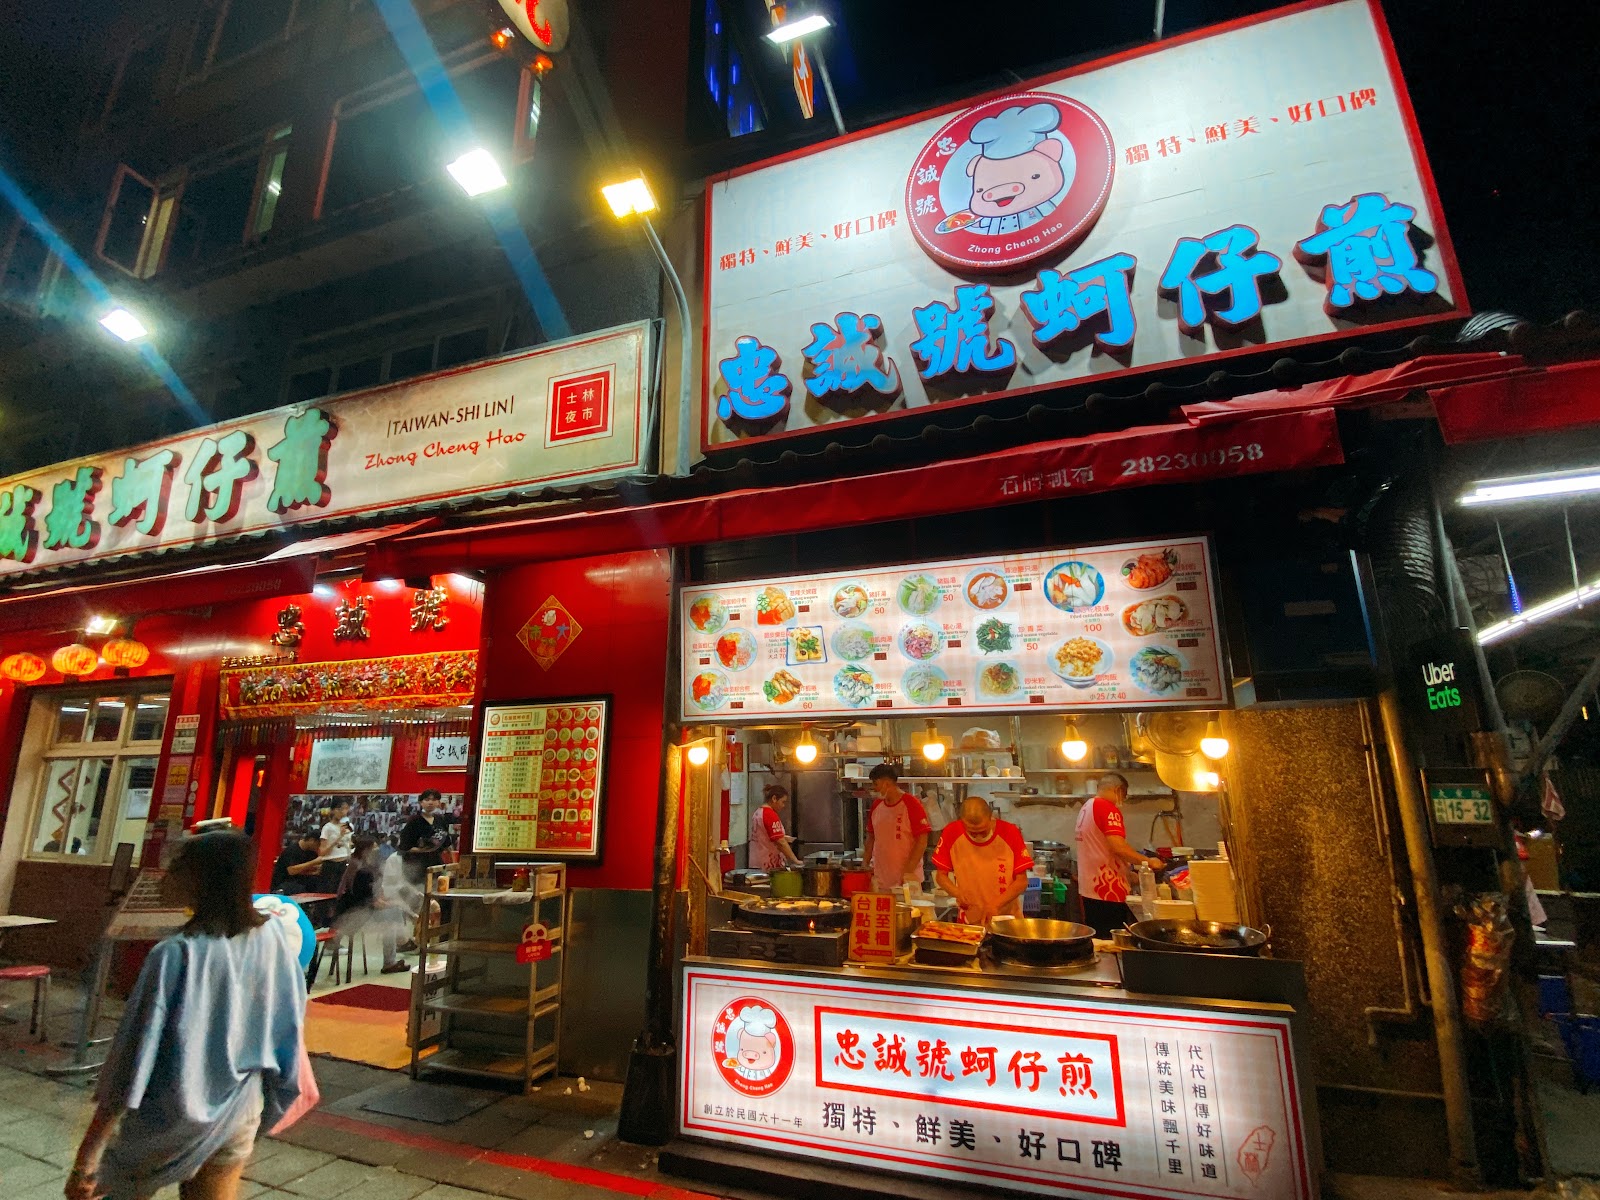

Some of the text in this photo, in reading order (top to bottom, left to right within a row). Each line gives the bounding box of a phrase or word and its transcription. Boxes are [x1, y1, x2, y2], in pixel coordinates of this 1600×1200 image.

[1125, 88, 1377, 165] 獨特、鮮美、好口碑
[719, 209, 897, 271] 獨特、鮮美、好口碑
[968, 222, 1063, 254] Zhong Cheng Hao
[717, 192, 1440, 421] 忠誠號蚵仔煎
[566, 388, 595, 404] 士林
[565, 407, 593, 424] 夜市
[364, 428, 527, 470] Zhong Cheng Hao
[1084, 624, 1102, 632] 100
[1422, 662, 1455, 686] Uber
[802, 702, 813, 710] 60
[1427, 685, 1461, 710] Eats
[1107, 811, 1121, 822] 40
[834, 1028, 1098, 1100] 忠誠號蚵仔煎
[734, 1078, 748, 1090] Zhong
[703, 1103, 803, 1129] 創立於民國六十一年
[1154, 1040, 1184, 1176] 傳統美味飄千里
[1187, 1044, 1218, 1180] 代代相傳好味道
[822, 1101, 1123, 1173] 獨特、鮮美、好口碑
